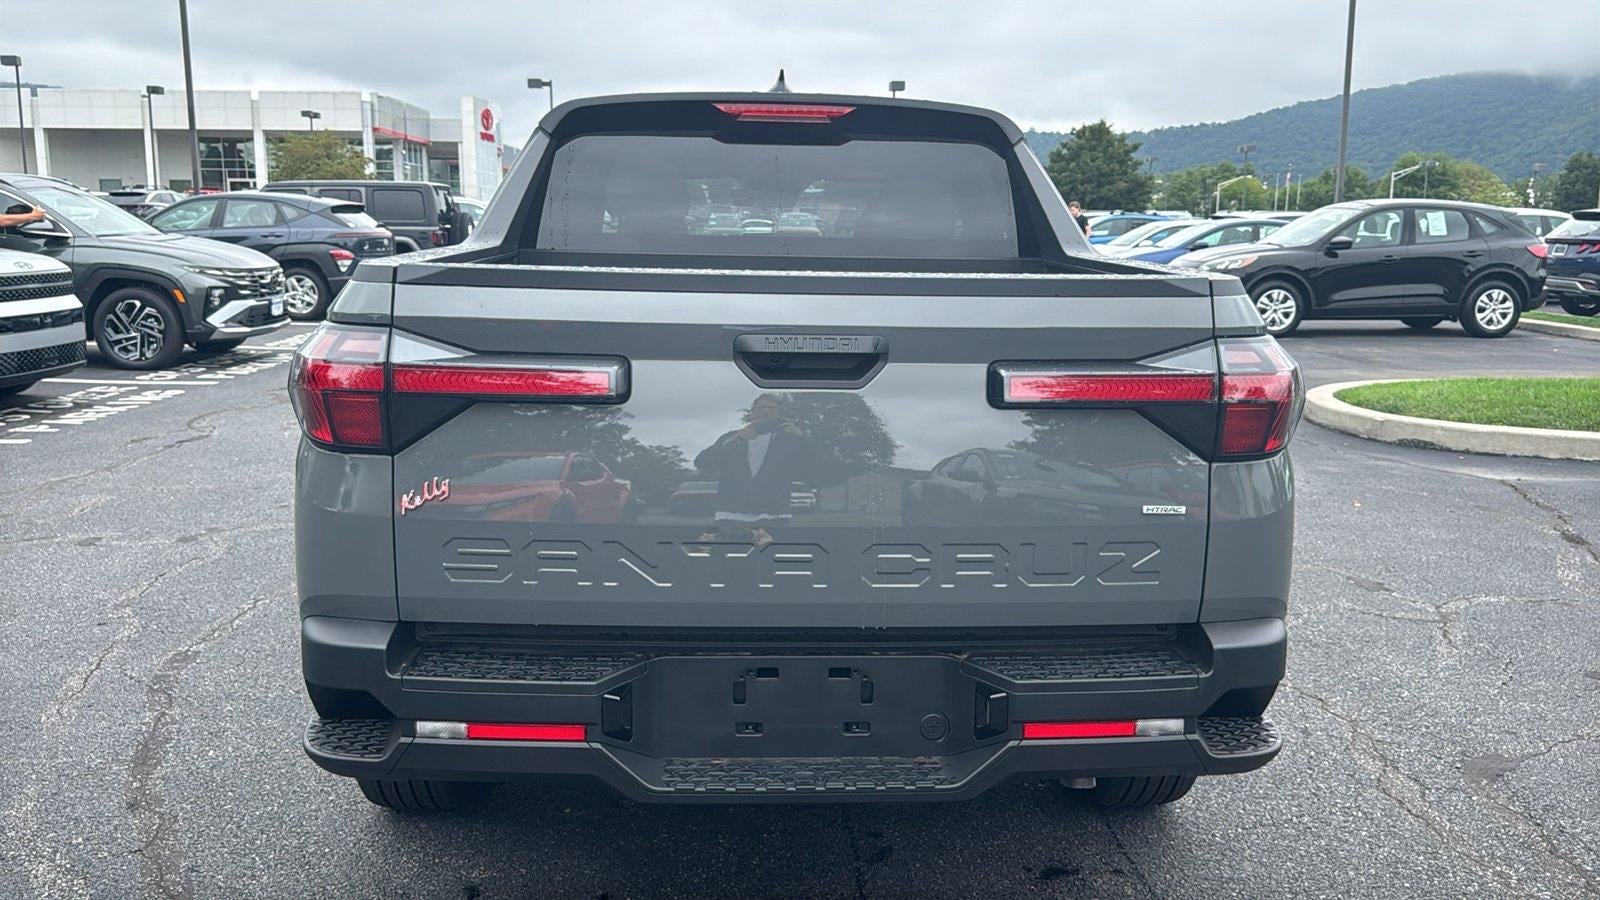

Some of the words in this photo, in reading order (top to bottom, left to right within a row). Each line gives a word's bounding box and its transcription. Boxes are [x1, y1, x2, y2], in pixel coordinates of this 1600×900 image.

[764, 336, 860, 351] HYUNDAI
[401, 476, 450, 515] Kelly
[442, 537, 829, 588] SANTA
[861, 541, 1164, 587] CRUZ
